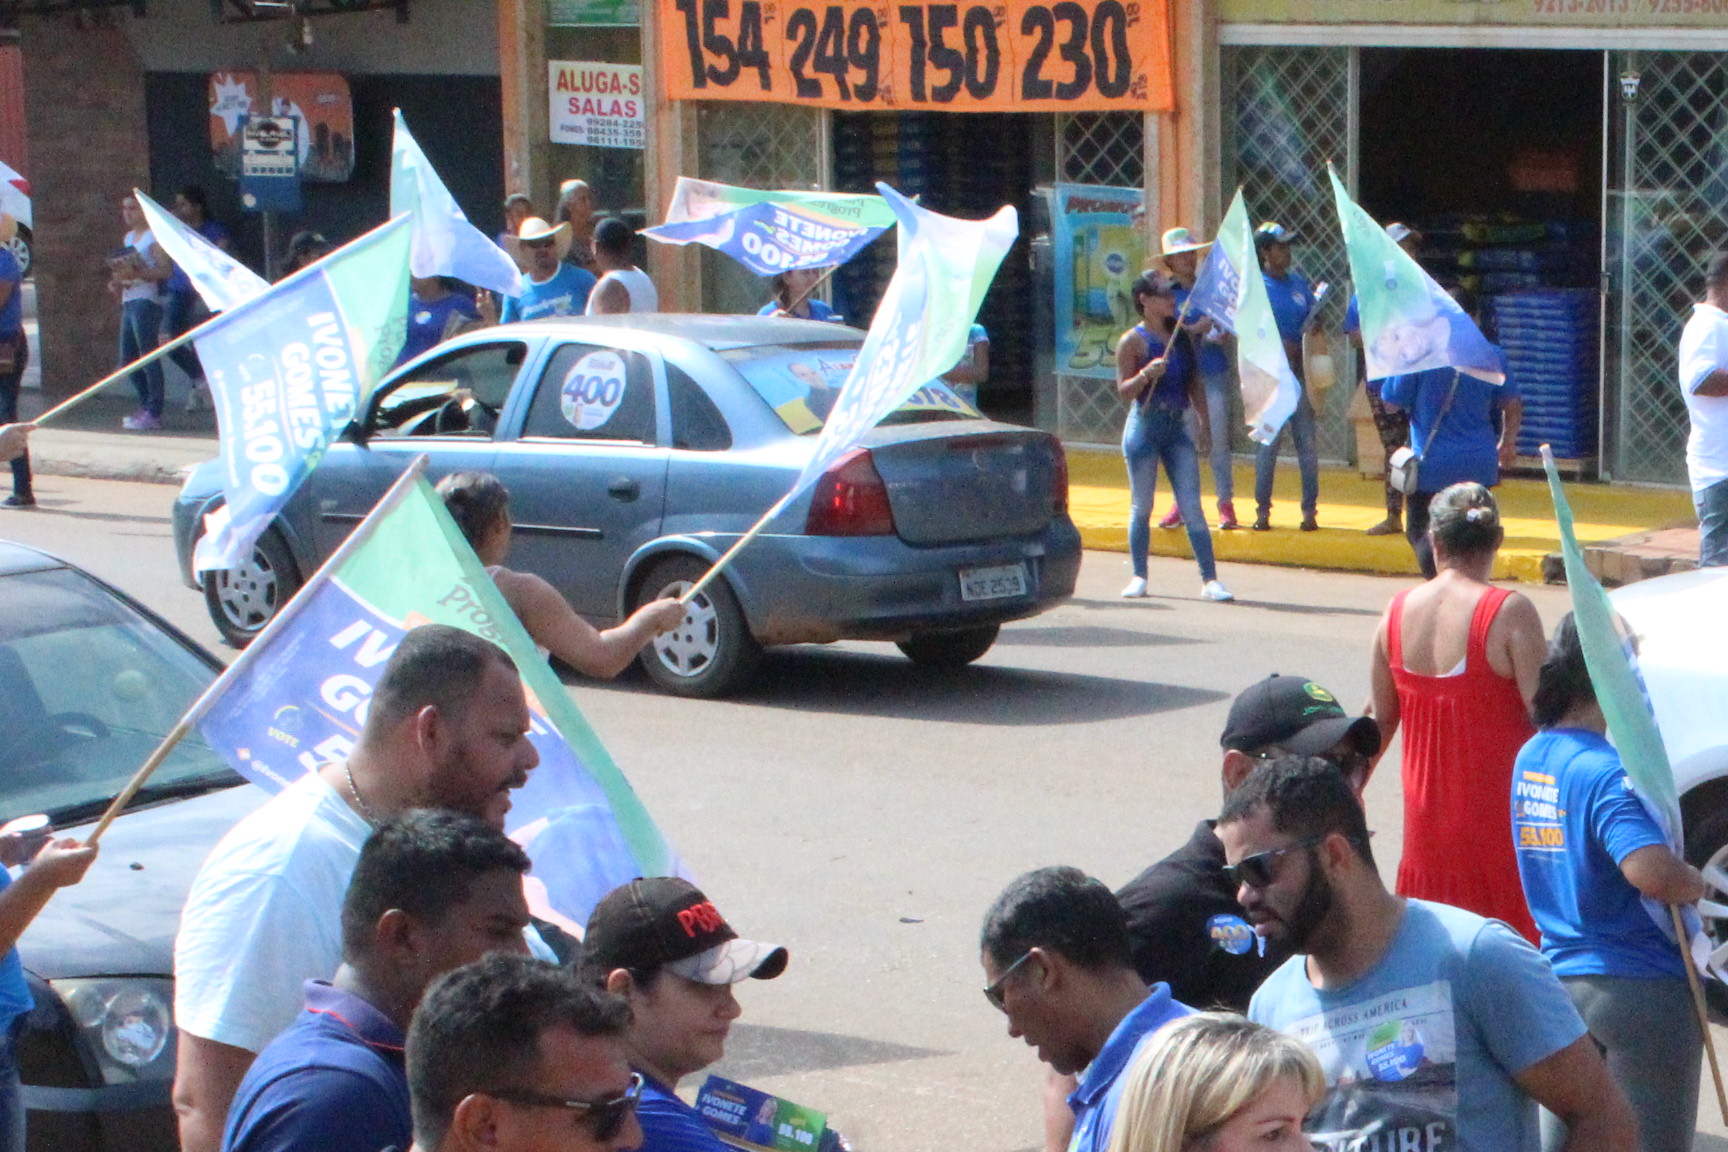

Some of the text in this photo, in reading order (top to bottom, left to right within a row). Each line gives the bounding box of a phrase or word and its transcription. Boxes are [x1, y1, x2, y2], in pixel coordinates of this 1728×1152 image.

[675, 0, 771, 91] 154
[786, 6, 881, 102] 249
[899, 5, 1000, 103] 150
[1021, 0, 1132, 99] 230
[568, 96, 637, 118] SALAS
[306, 312, 358, 432] IVONE
[282, 342, 326, 449] GOMES
[563, 374, 621, 407] 400
[241, 379, 290, 496] 55.100
[267, 725, 300, 749] VOTE
[1524, 800, 1558, 820] GOMES
[1520, 826, 1565, 847] 55.100
[1323, 1014, 1360, 1030] ACROSS
[1363, 998, 1408, 1022] AMERICA
[702, 1093, 748, 1116] IVONETE
[702, 1106, 741, 1125] GOMES
